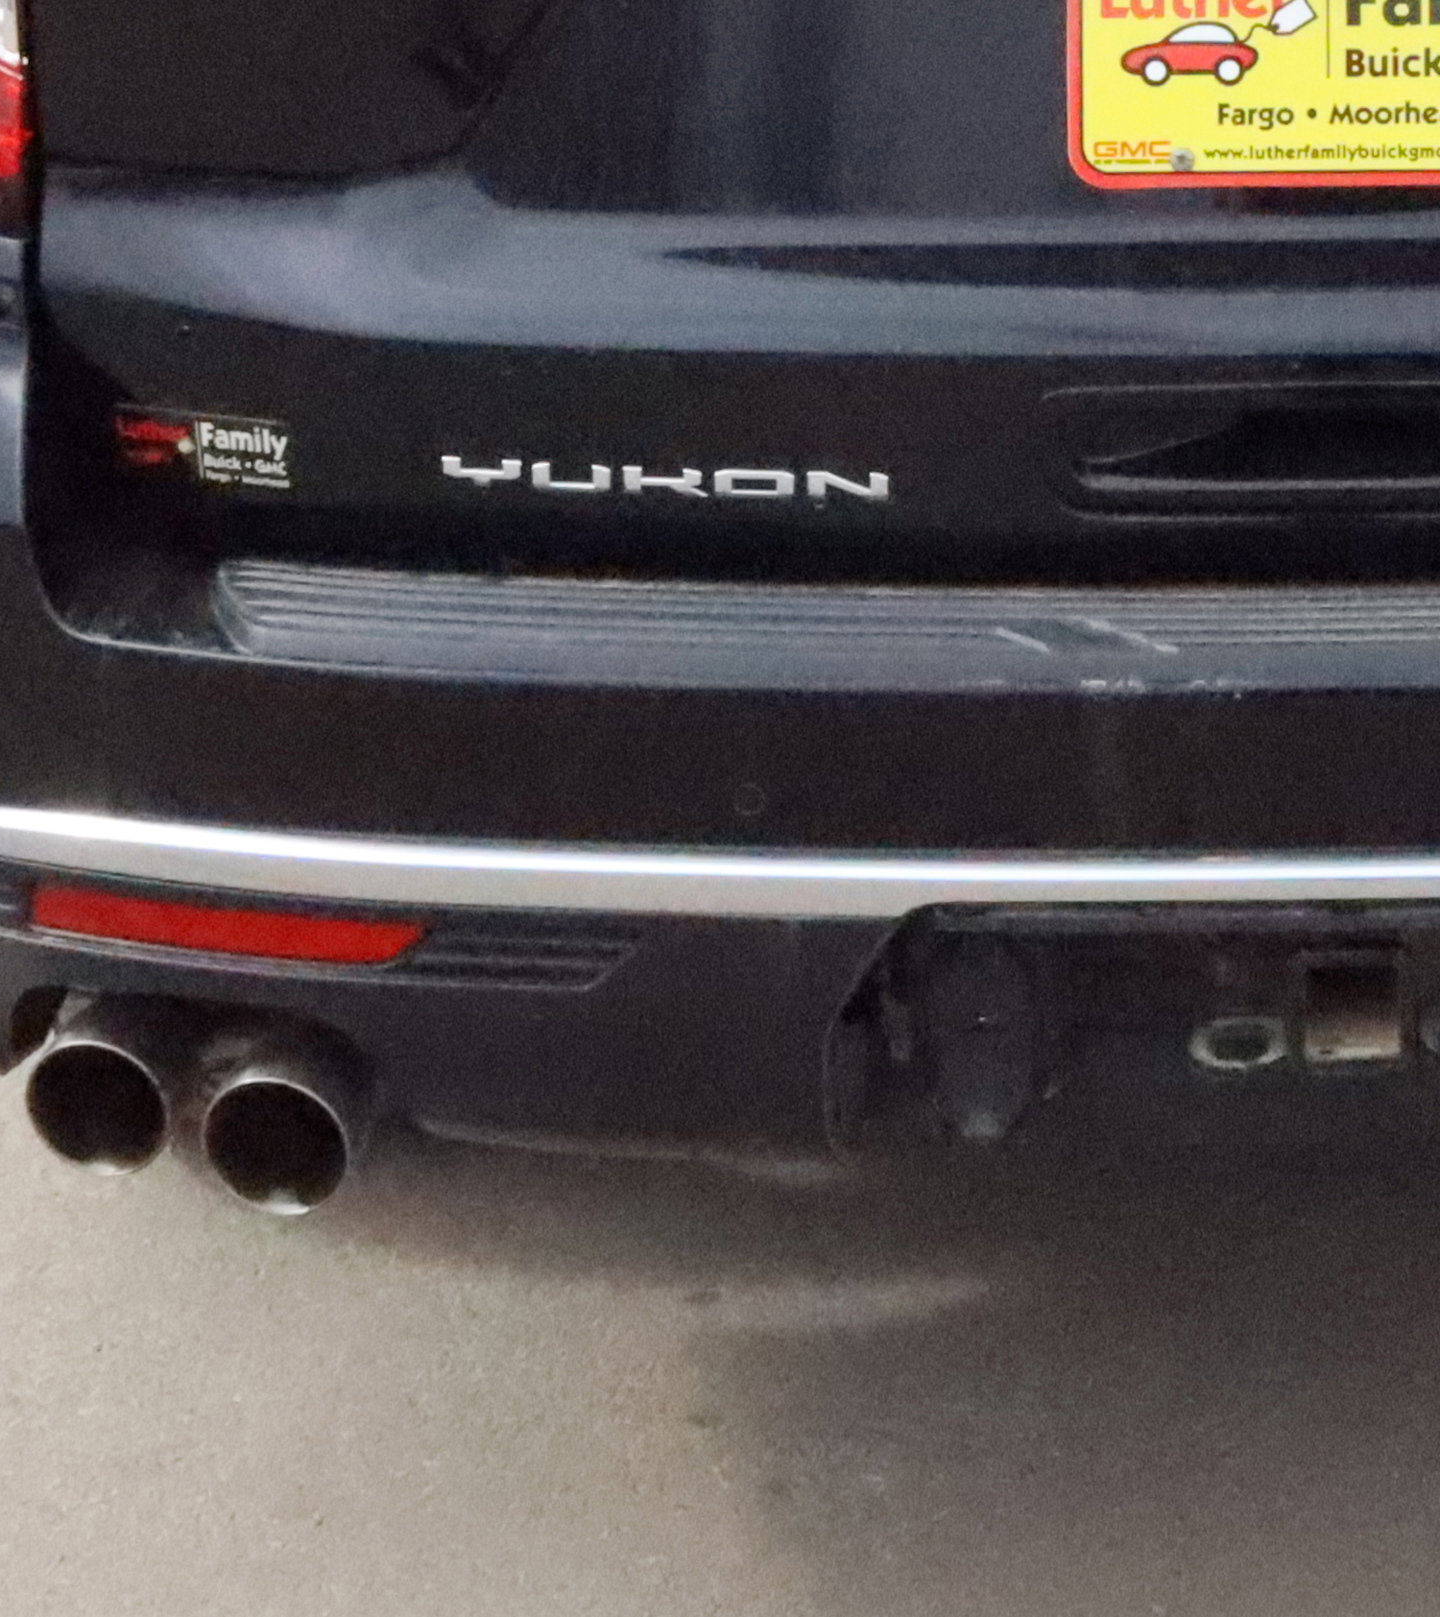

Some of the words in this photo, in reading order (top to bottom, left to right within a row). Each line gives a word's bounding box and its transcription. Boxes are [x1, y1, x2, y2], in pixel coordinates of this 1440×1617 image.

[1217, 102, 1294, 130] Fargo
[1093, 141, 1171, 157] GMC
[200, 421, 287, 461] Family
[441, 456, 888, 497] YUKON
